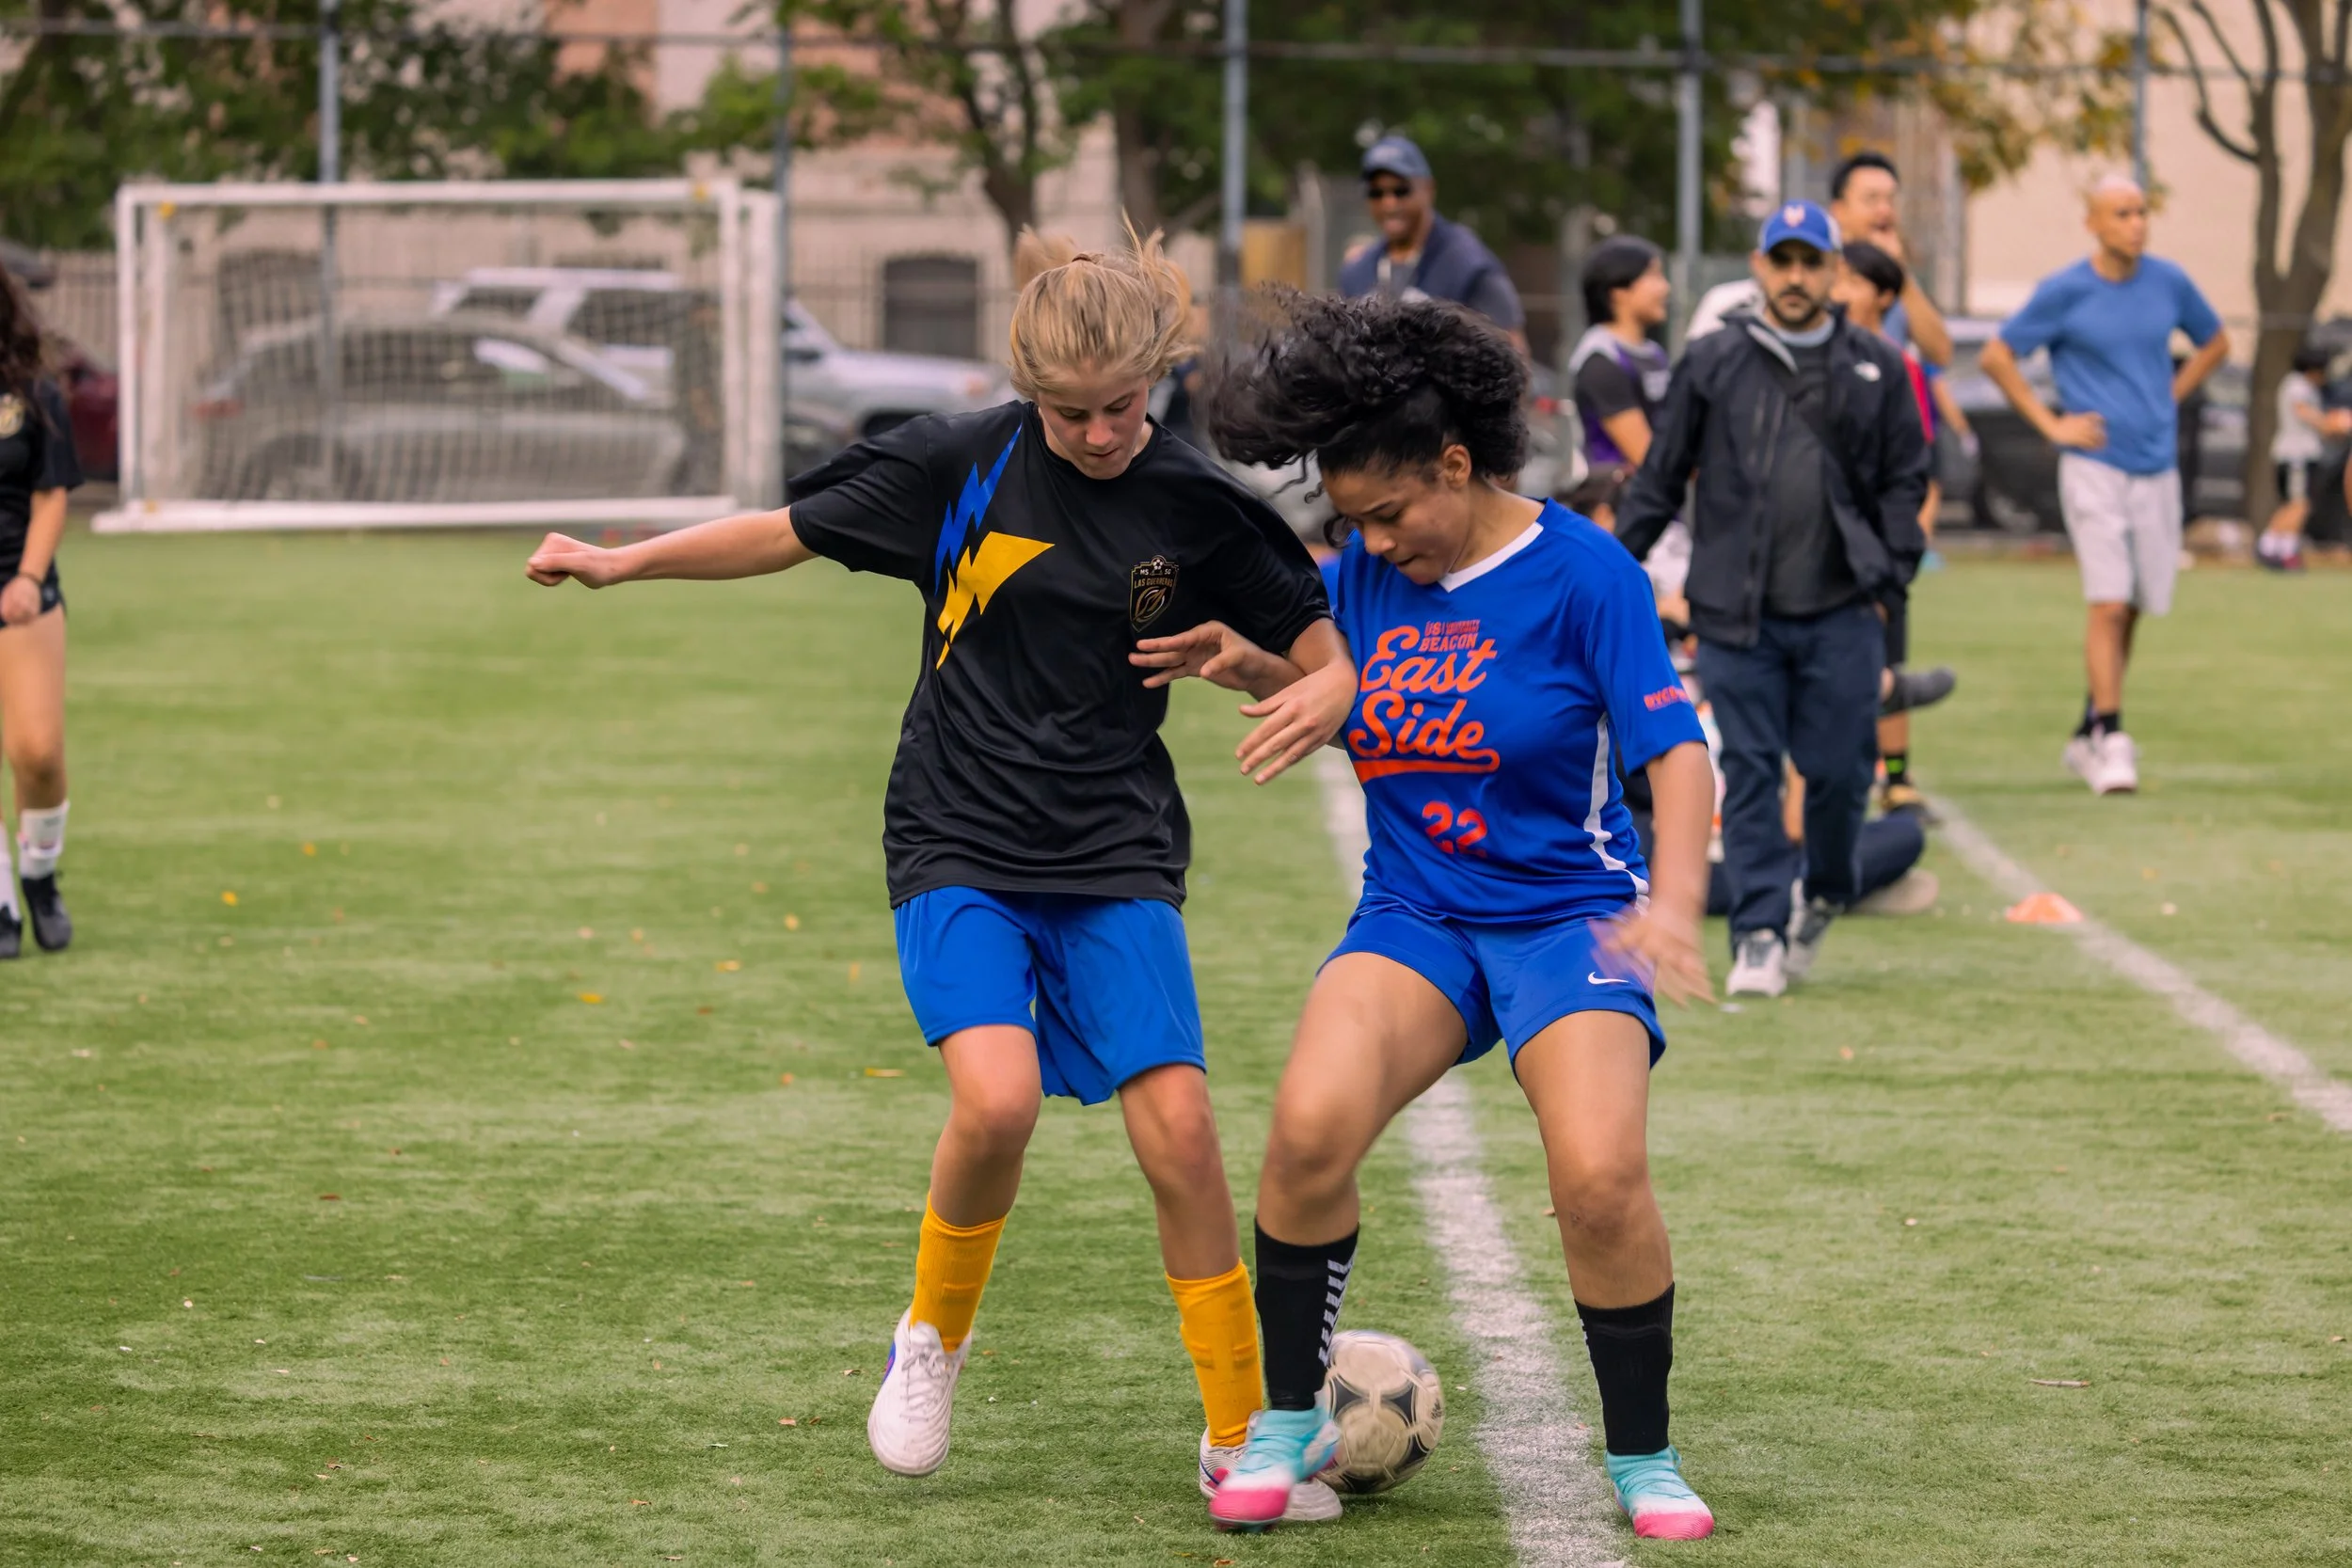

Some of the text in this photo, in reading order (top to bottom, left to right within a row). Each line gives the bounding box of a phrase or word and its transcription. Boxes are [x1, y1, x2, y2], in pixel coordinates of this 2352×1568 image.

[1134, 578, 1145, 588] LAS
[1360, 625, 1498, 693] East
[1418, 633, 1478, 652] BEACON
[1348, 689, 1501, 761] Side
[1422, 800, 1487, 857] 22
